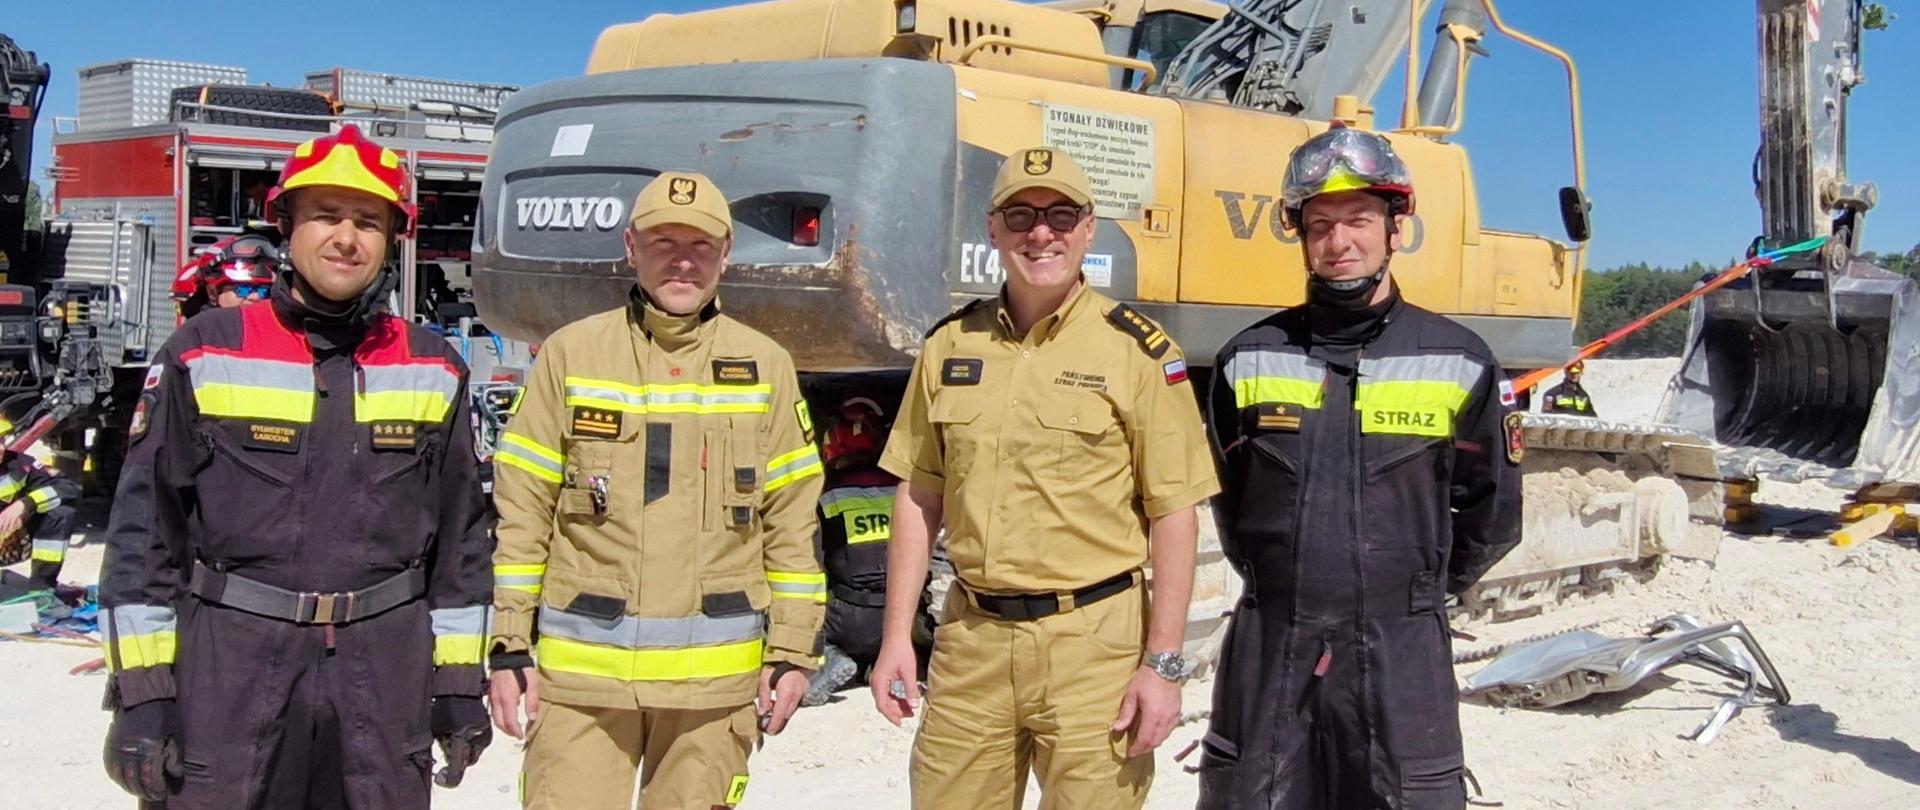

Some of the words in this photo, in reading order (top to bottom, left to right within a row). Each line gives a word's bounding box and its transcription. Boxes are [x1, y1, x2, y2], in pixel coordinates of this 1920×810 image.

[516, 197, 624, 231] VOLVO
[960, 242, 1007, 284] EC4
[854, 513, 890, 536] STR
